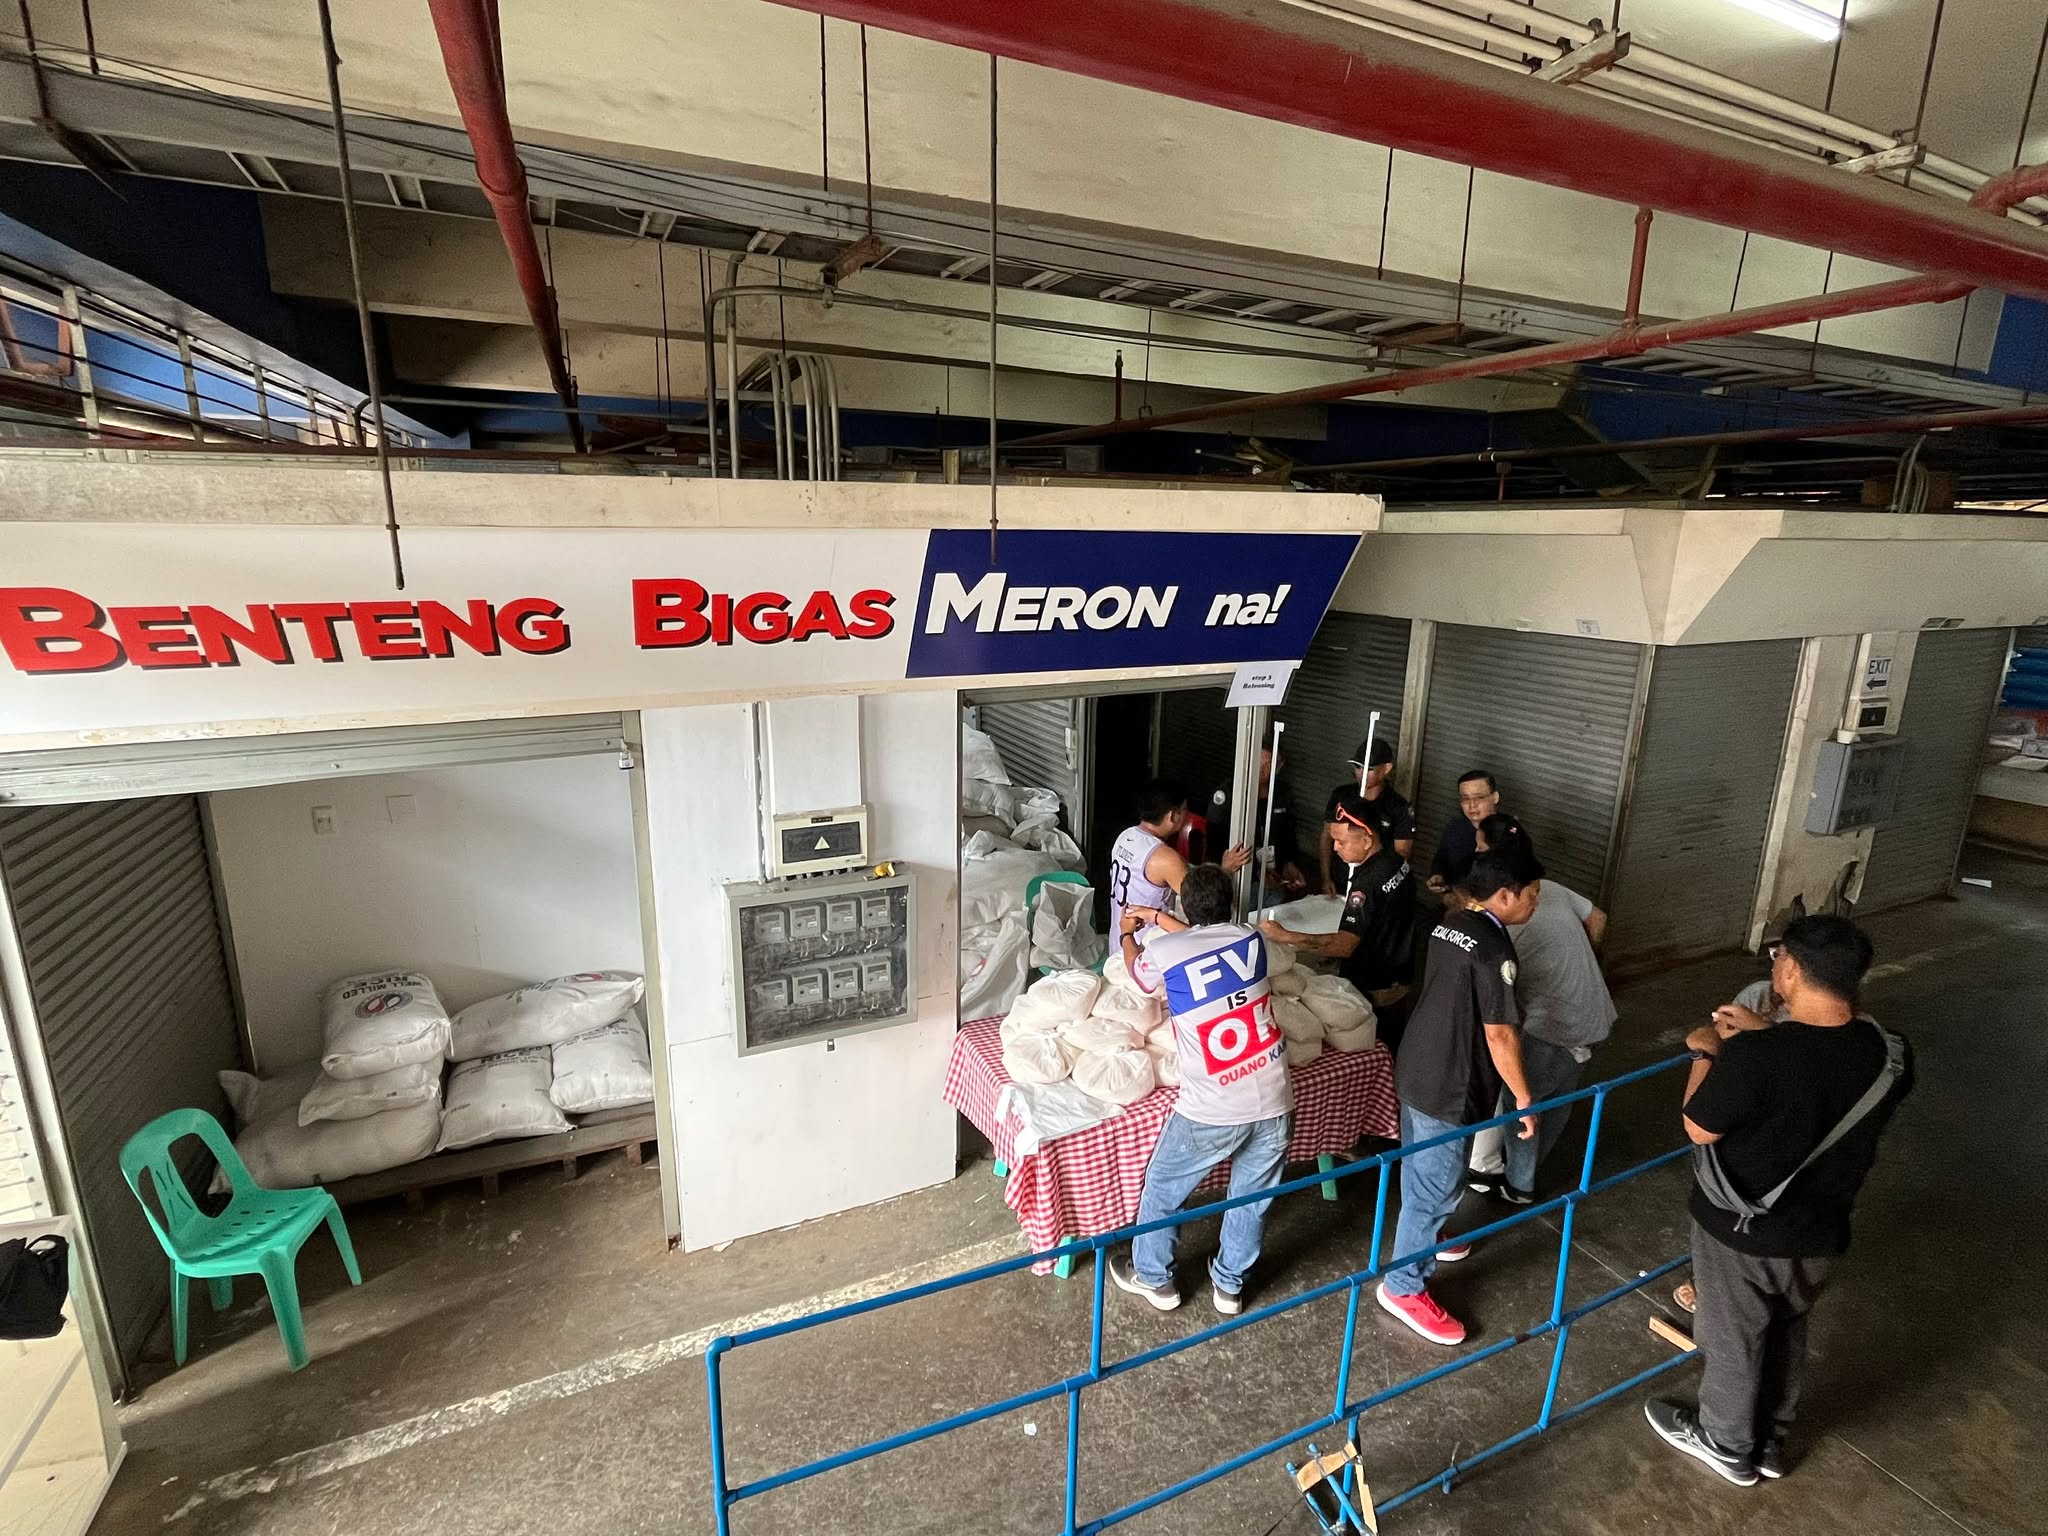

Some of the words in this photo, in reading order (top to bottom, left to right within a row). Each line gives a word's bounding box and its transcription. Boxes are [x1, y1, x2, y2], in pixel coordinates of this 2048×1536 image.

[925, 572, 1178, 634] MERON
[1204, 584, 1292, 627] na!
[0, 587, 571, 675] BENTENG
[632, 578, 897, 650] BIGAS
[1867, 658, 1891, 675] EXIT
[1447, 929, 1479, 953] FORCE
[1184, 938, 1259, 1002] FV
[342, 983, 387, 1000] MILLED
[1226, 991, 1248, 1011] IS
[1208, 1002, 1276, 1062] OK
[1219, 1056, 1267, 1087] OUANO
